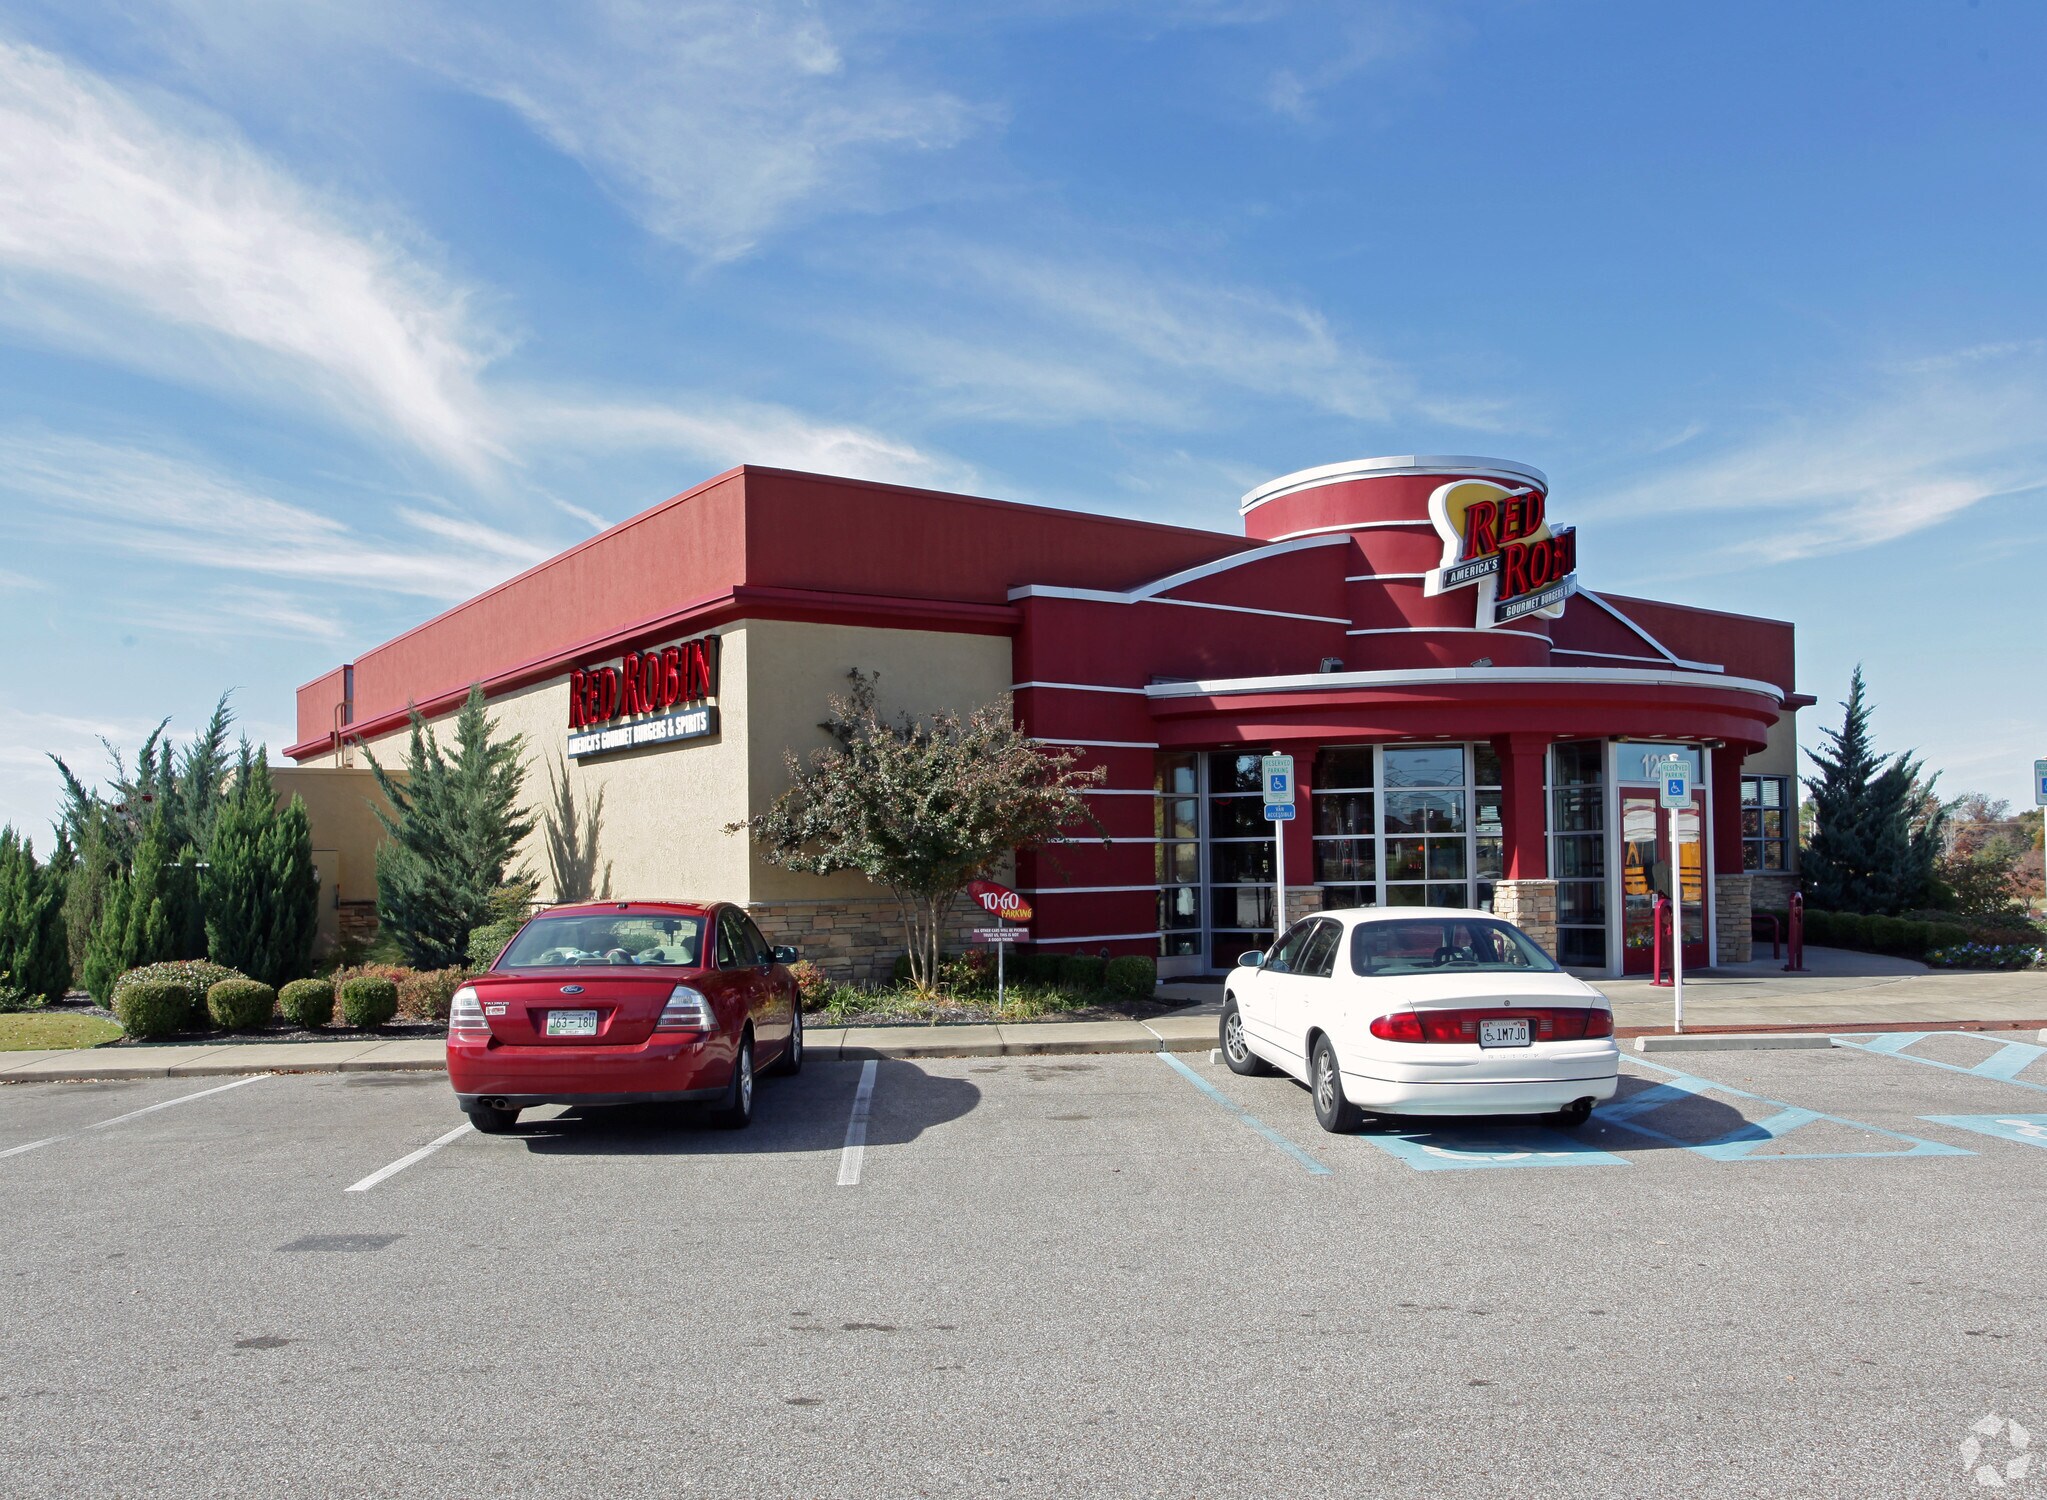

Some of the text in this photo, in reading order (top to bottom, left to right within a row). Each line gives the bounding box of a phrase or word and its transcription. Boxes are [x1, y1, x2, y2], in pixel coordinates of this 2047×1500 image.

[1460, 490, 1545, 562] RED
[1450, 560, 1498, 583] AMERICA'S
[1506, 597, 1540, 617] GOURMET
[1541, 588, 1564, 605] BURGERS
[568, 635, 717, 729] RED ROBIN
[568, 711, 707, 755] AMERICA'S GOURMET BURGERS & SPIRITS
[1663, 764, 1688, 772] RESERVED
[979, 891, 1019, 910] TO-GO
[1001, 908, 1033, 918] PARKING
